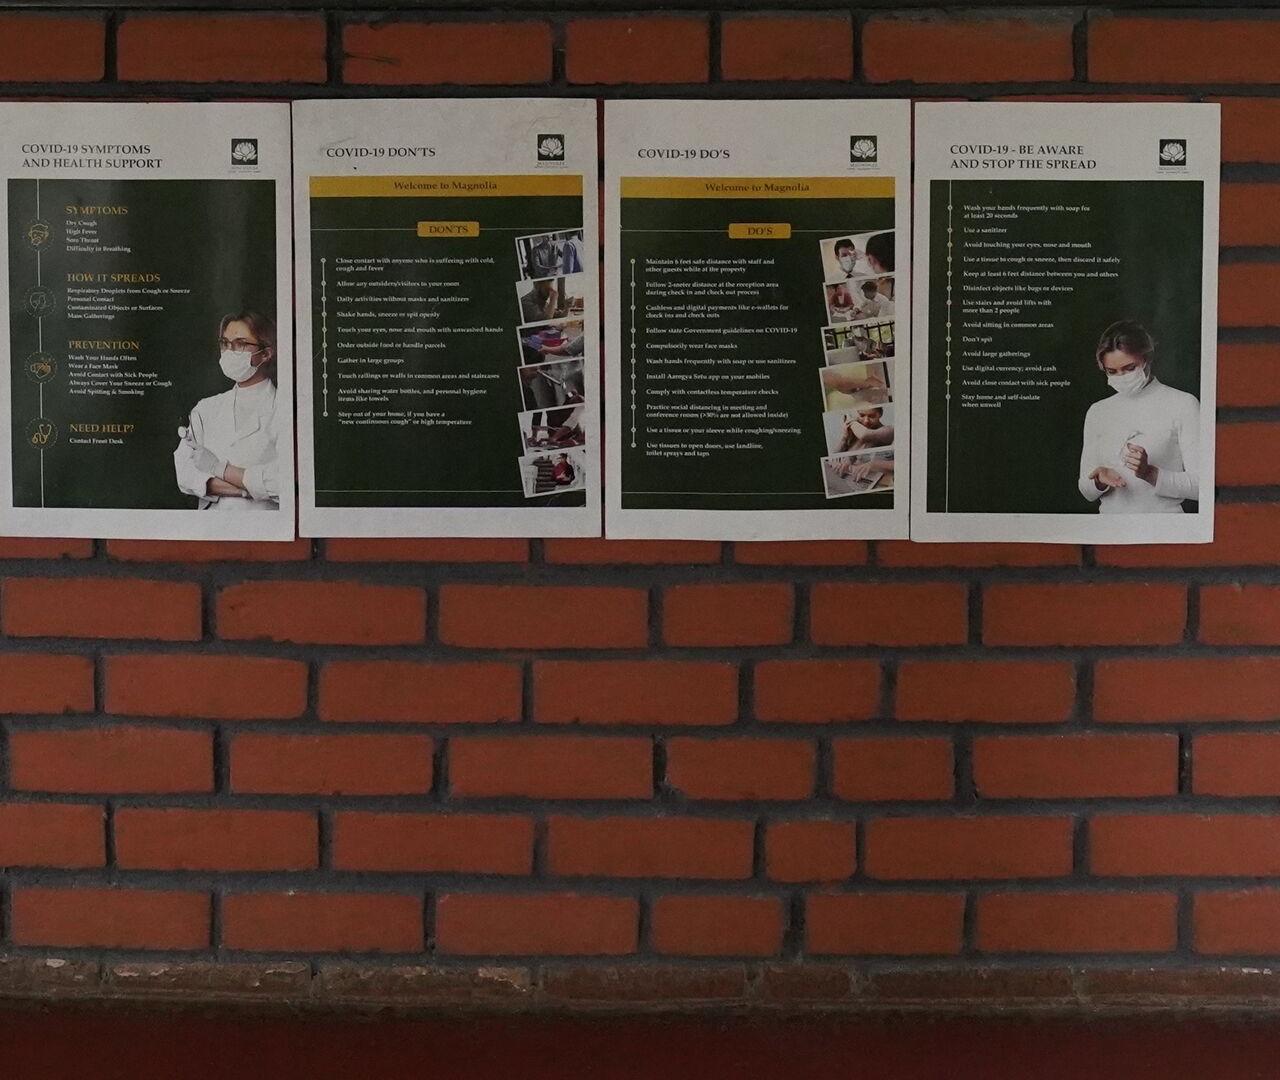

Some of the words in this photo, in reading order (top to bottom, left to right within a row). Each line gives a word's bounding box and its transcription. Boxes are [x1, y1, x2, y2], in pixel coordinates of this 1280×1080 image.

[22, 144, 78, 154] COVID-19
[81, 144, 150, 154] SYMPTOMS
[326, 148, 385, 157] COVID-19
[388, 148, 435, 157] DON'TS
[951, 145, 1008, 154] COVID-19
[1019, 145, 1033, 154] BE
[1038, 146, 1084, 154] AWARE
[638, 149, 696, 158] COVID-19
[700, 149, 730, 159] DO'S
[22, 158, 50, 168] AND
[53, 159, 102, 168] HEALTH
[105, 159, 162, 168] SUPPORT
[951, 160, 978, 168] AND
[982, 160, 1015, 169] STOP
[1019, 160, 1043, 169] THE
[1046, 160, 1096, 169] SPREAD
[394, 182, 436, 190] Welcome
[440, 182, 449, 190] to
[452, 182, 497, 191] Magnolia
[705, 184, 749, 192] Welcome
[764, 184, 809, 193] Magnolia
[65, 206, 128, 215] SYMPTOMS
[429, 225, 468, 233] DON'TS
[747, 227, 772, 236] DO'S
[68, 273, 93, 282] HOW
[110, 274, 160, 282] SPREADS
[69, 341, 139, 349] PREVENTION
[71, 424, 99, 432] NEED
